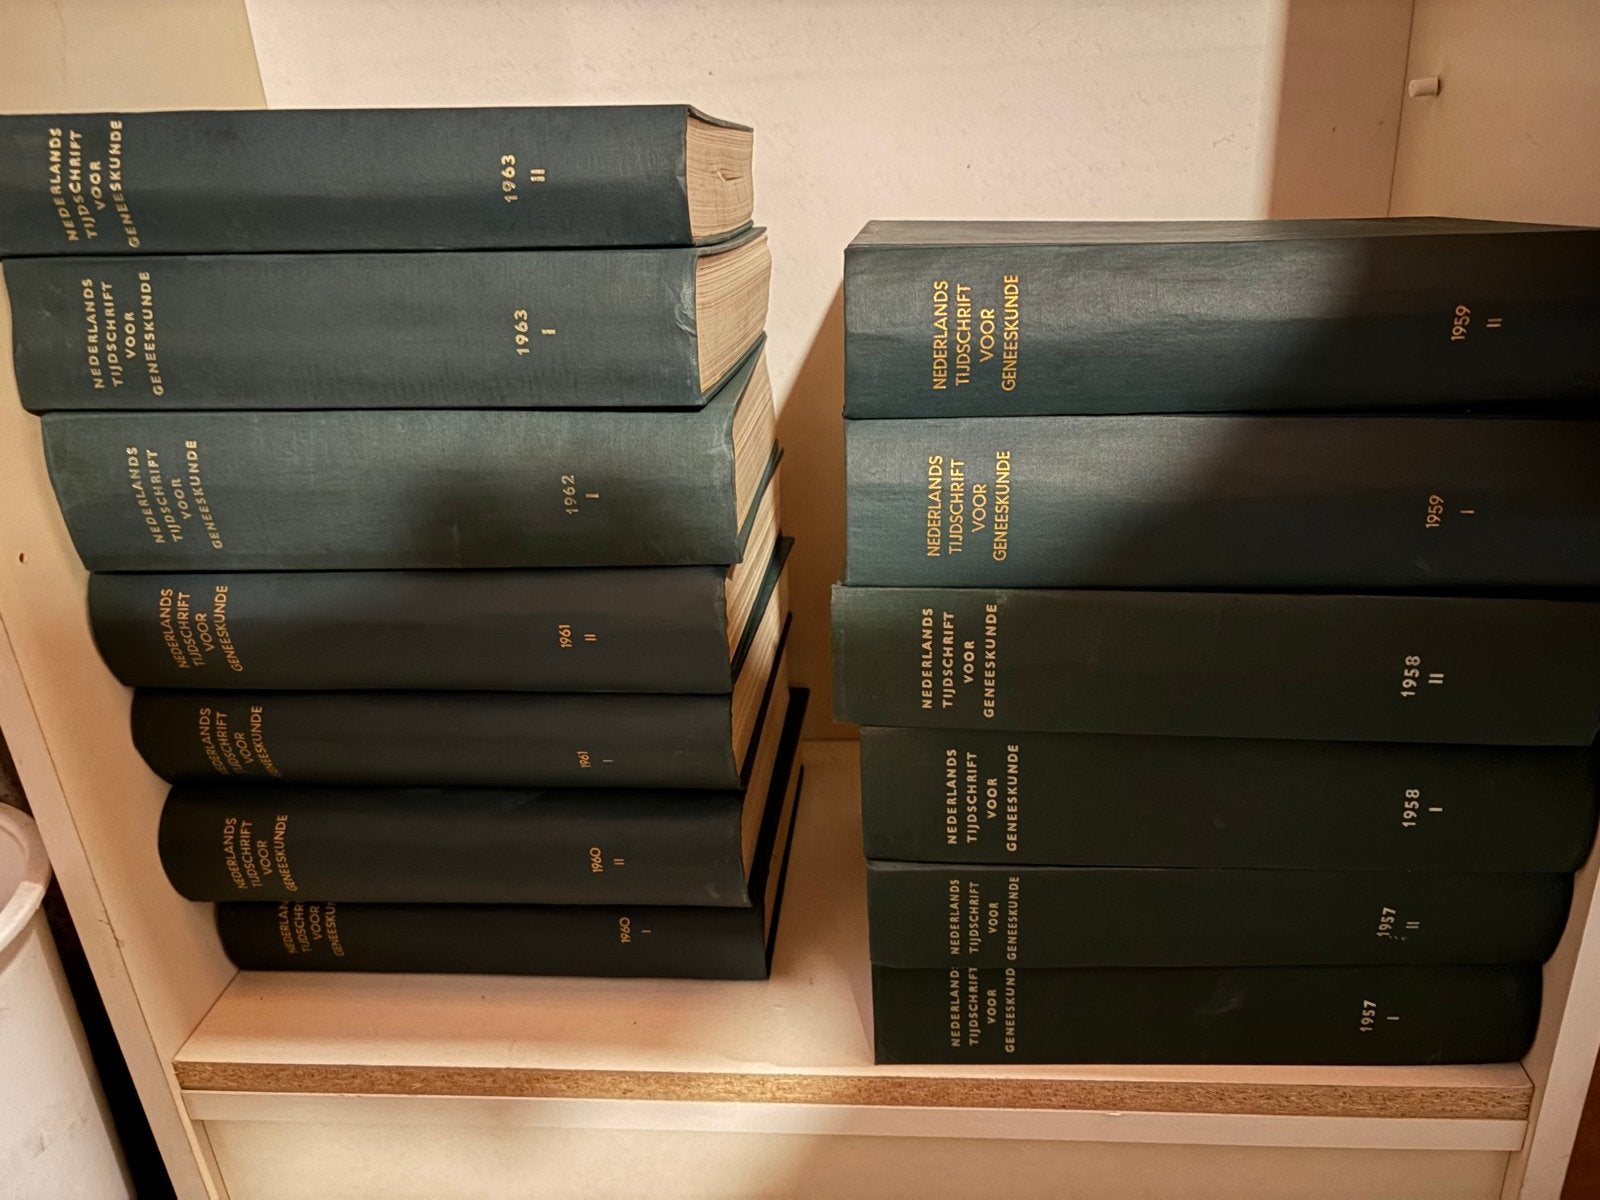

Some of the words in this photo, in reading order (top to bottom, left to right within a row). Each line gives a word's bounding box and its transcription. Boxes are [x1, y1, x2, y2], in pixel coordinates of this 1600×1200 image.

[48, 127, 80, 241] NEDERLANDS
[68, 130, 98, 239] TIJDSCHRIFT
[89, 160, 106, 211] VOOR
[109, 120, 141, 248] GENEESKUNDE
[501, 154, 518, 203] 1963
[530, 168, 546, 183] II
[81, 278, 105, 389] NEDERLANDS
[100, 281, 125, 387] TIJDSCHRIFT
[124, 312, 136, 359] VOOR
[138, 271, 164, 397] GENEESKUNDE
[514, 309, 530, 356] 1963
[933, 280, 948, 389] NEDERLANDS
[956, 284, 972, 386] TIJDSCHRIFT
[979, 308, 995, 362] VOOR
[1002, 274, 1019, 391] GENEESKUNDE
[1451, 304, 1471, 341] 1959
[1486, 318, 1503, 328] II
[126, 446, 165, 543] NEDERLANDS
[146, 449, 183, 542] TIJDSCHRIFT
[171, 478, 192, 520] VOOR
[185, 440, 223, 549] GENEESKUNDE
[562, 474, 579, 514] 1962
[927, 455, 943, 557] NEDERLANDS
[949, 459, 965, 554] TIJDSCHRIFT
[972, 484, 986, 533] VOOR
[993, 451, 1010, 561] GENEESKUNDE
[1425, 494, 1444, 528] 1959
[160, 588, 190, 669] NEDERLANDS
[177, 592, 204, 666] TIJDSCHRIFT
[195, 613, 215, 651] VOOR
[213, 585, 244, 672] GENEESKUNDE
[559, 624, 572, 648] 1961
[584, 633, 597, 642] II
[922, 608, 933, 709] NEDERLANDS
[942, 612, 955, 708] TIJDSCHRIFT
[963, 640, 975, 684] VOOR
[984, 604, 998, 718] GENEESKUNDE
[1401, 655, 1421, 697] 1958
[1428, 673, 1444, 684] II
[234, 731, 253, 764] VOOR
[578, 751, 590, 768] 1961
[946, 749, 957, 845] NEDERLANDS
[967, 752, 978, 844] TIJDSCHRIFT
[987, 777, 998, 819] VOOR
[1006, 745, 1019, 852] GENEESKUNDE
[1401, 788, 1420, 828] 1958
[223, 816, 248, 890] NEDERLANDS
[239, 819, 262, 888] TIJDSCHRIFT
[257, 840, 273, 875] VOOR
[273, 814, 298, 892] GENEESKUNDE
[590, 847, 603, 872] 1960
[613, 857, 624, 866] II
[308, 905, 322, 940] VOOR
[621, 917, 632, 943] 1960
[950, 879, 960, 955] NEDERLANDS
[969, 882, 981, 954] TIJDSCHRIFT
[988, 902, 999, 934] VOOR
[1007, 876, 1019, 960] GENEESKUNDE
[1376, 907, 1396, 938] 1957
[1405, 921, 1420, 929] II
[950, 966, 960, 1047] NEDERLAND
[969, 967, 981, 1046] TIJDSCHRIFT
[987, 989, 998, 1025] VOOR
[1360, 1000, 1376, 1032] 1957
